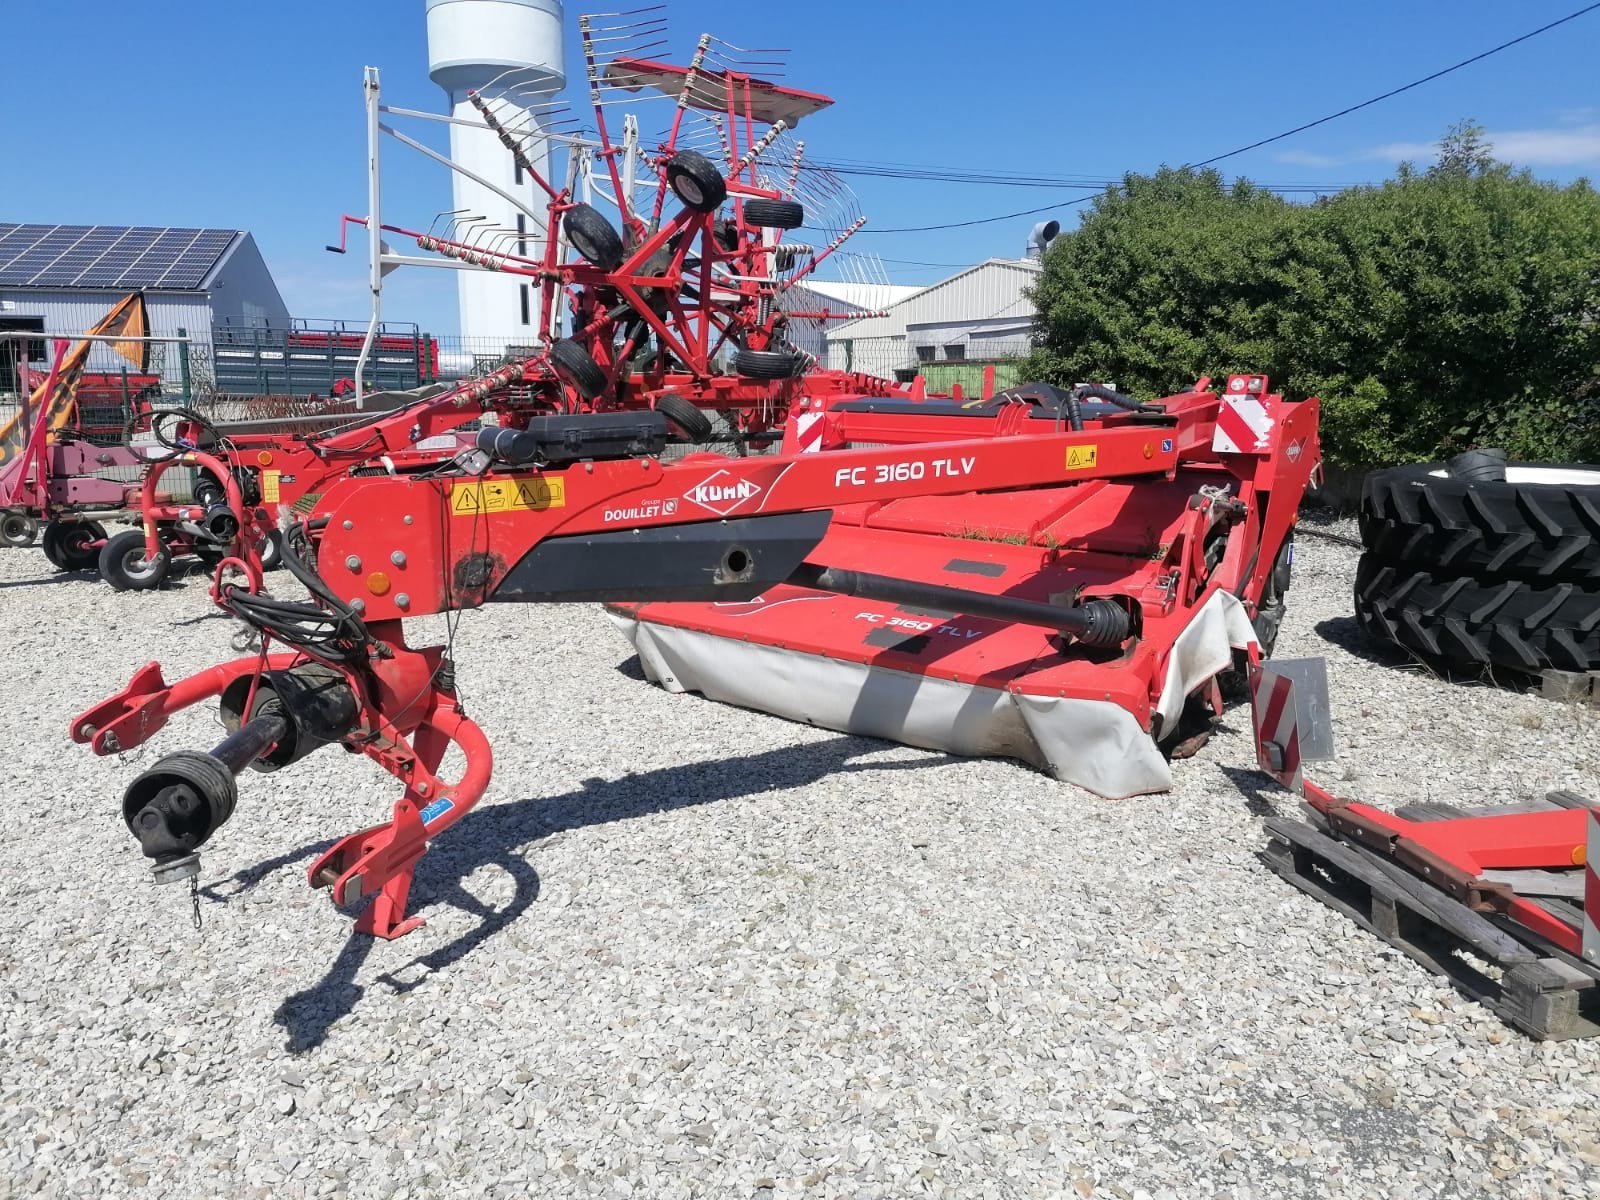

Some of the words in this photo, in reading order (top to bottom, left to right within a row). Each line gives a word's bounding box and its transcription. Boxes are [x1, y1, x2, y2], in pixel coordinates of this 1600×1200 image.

[835, 466, 866, 487] FC
[874, 461, 925, 484] 3160
[931, 456, 976, 478] TLV
[695, 481, 751, 503] KUHN
[604, 505, 660, 522] DOUILLET
[855, 612, 884, 622] FC
[886, 616, 934, 631] 3160
[938, 625, 983, 639] TLV
